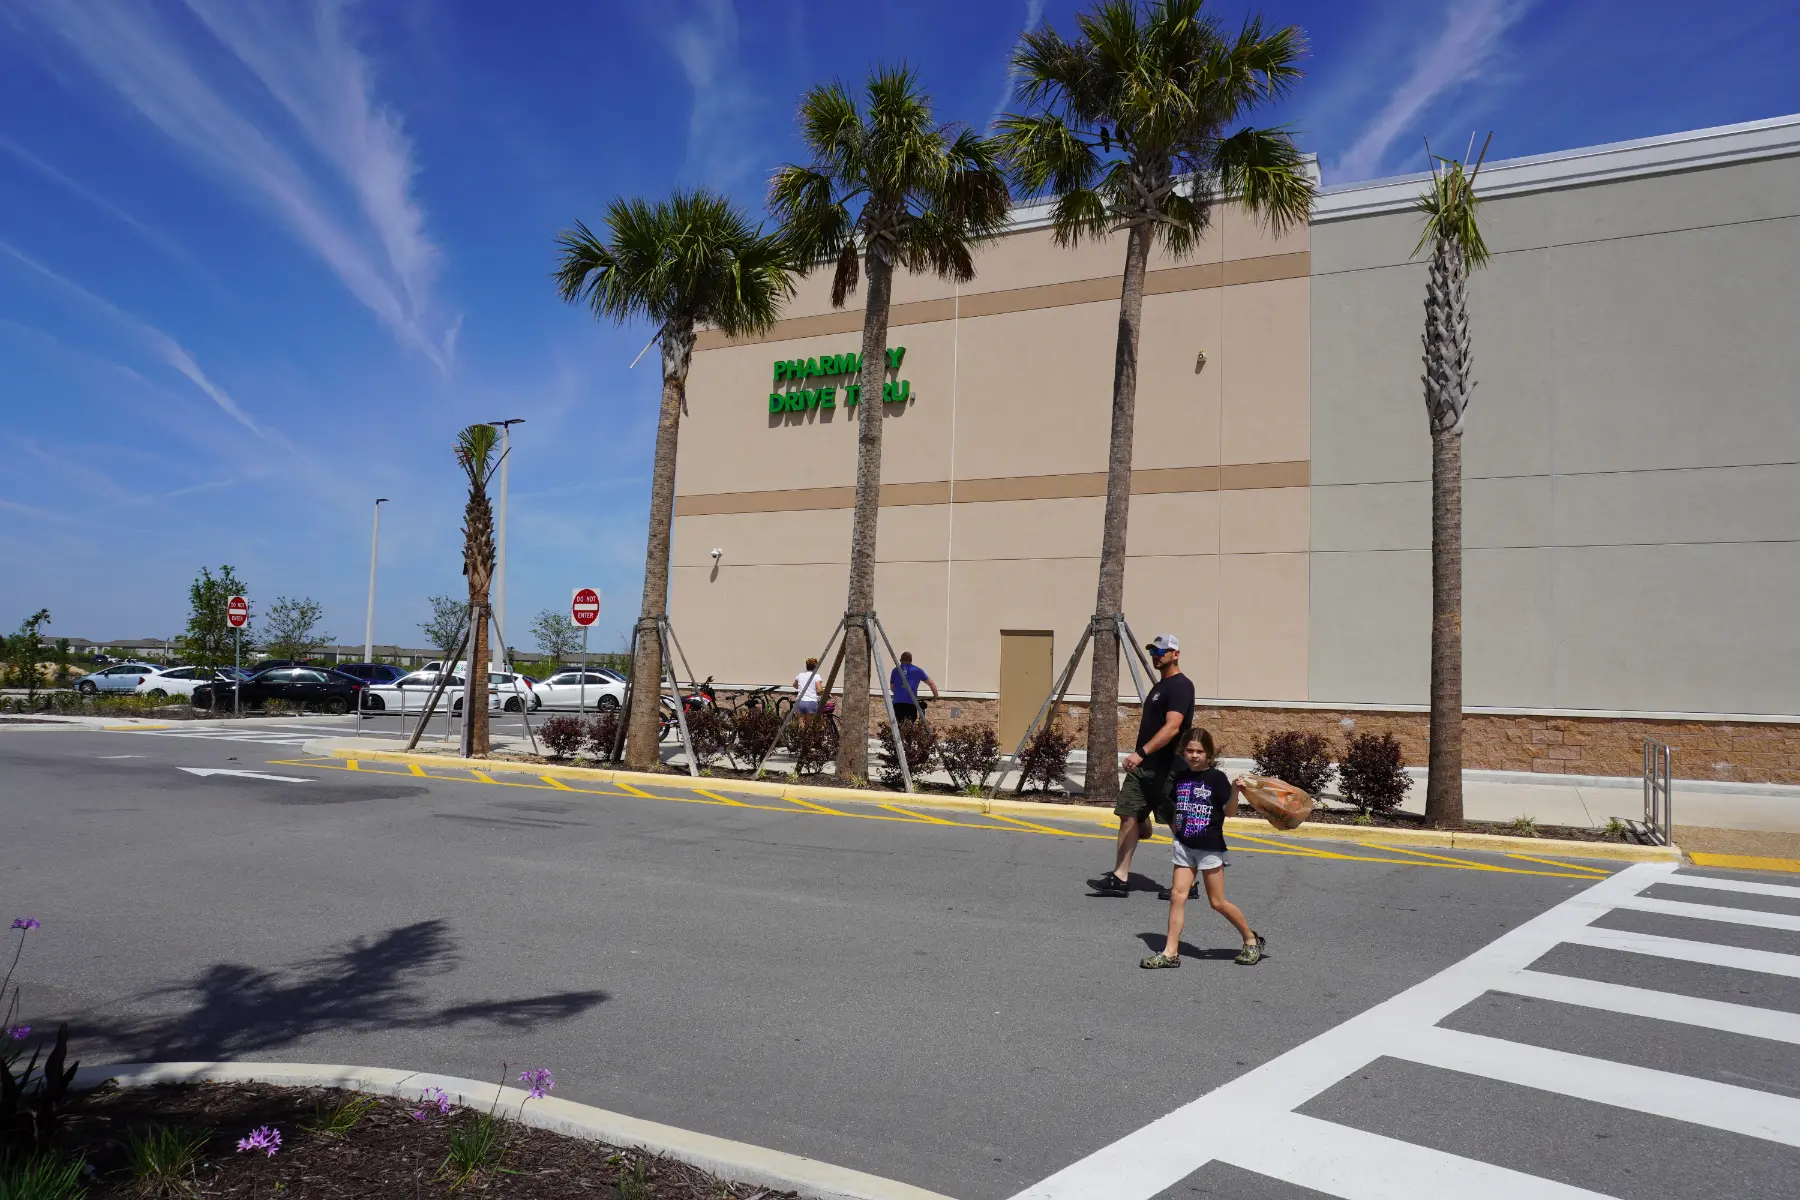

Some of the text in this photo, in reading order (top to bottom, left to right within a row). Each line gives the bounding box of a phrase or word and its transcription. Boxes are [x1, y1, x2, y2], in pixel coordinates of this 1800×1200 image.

[774, 347, 906, 381] PHARMY
[769, 380, 911, 413] DRIVE TRU
